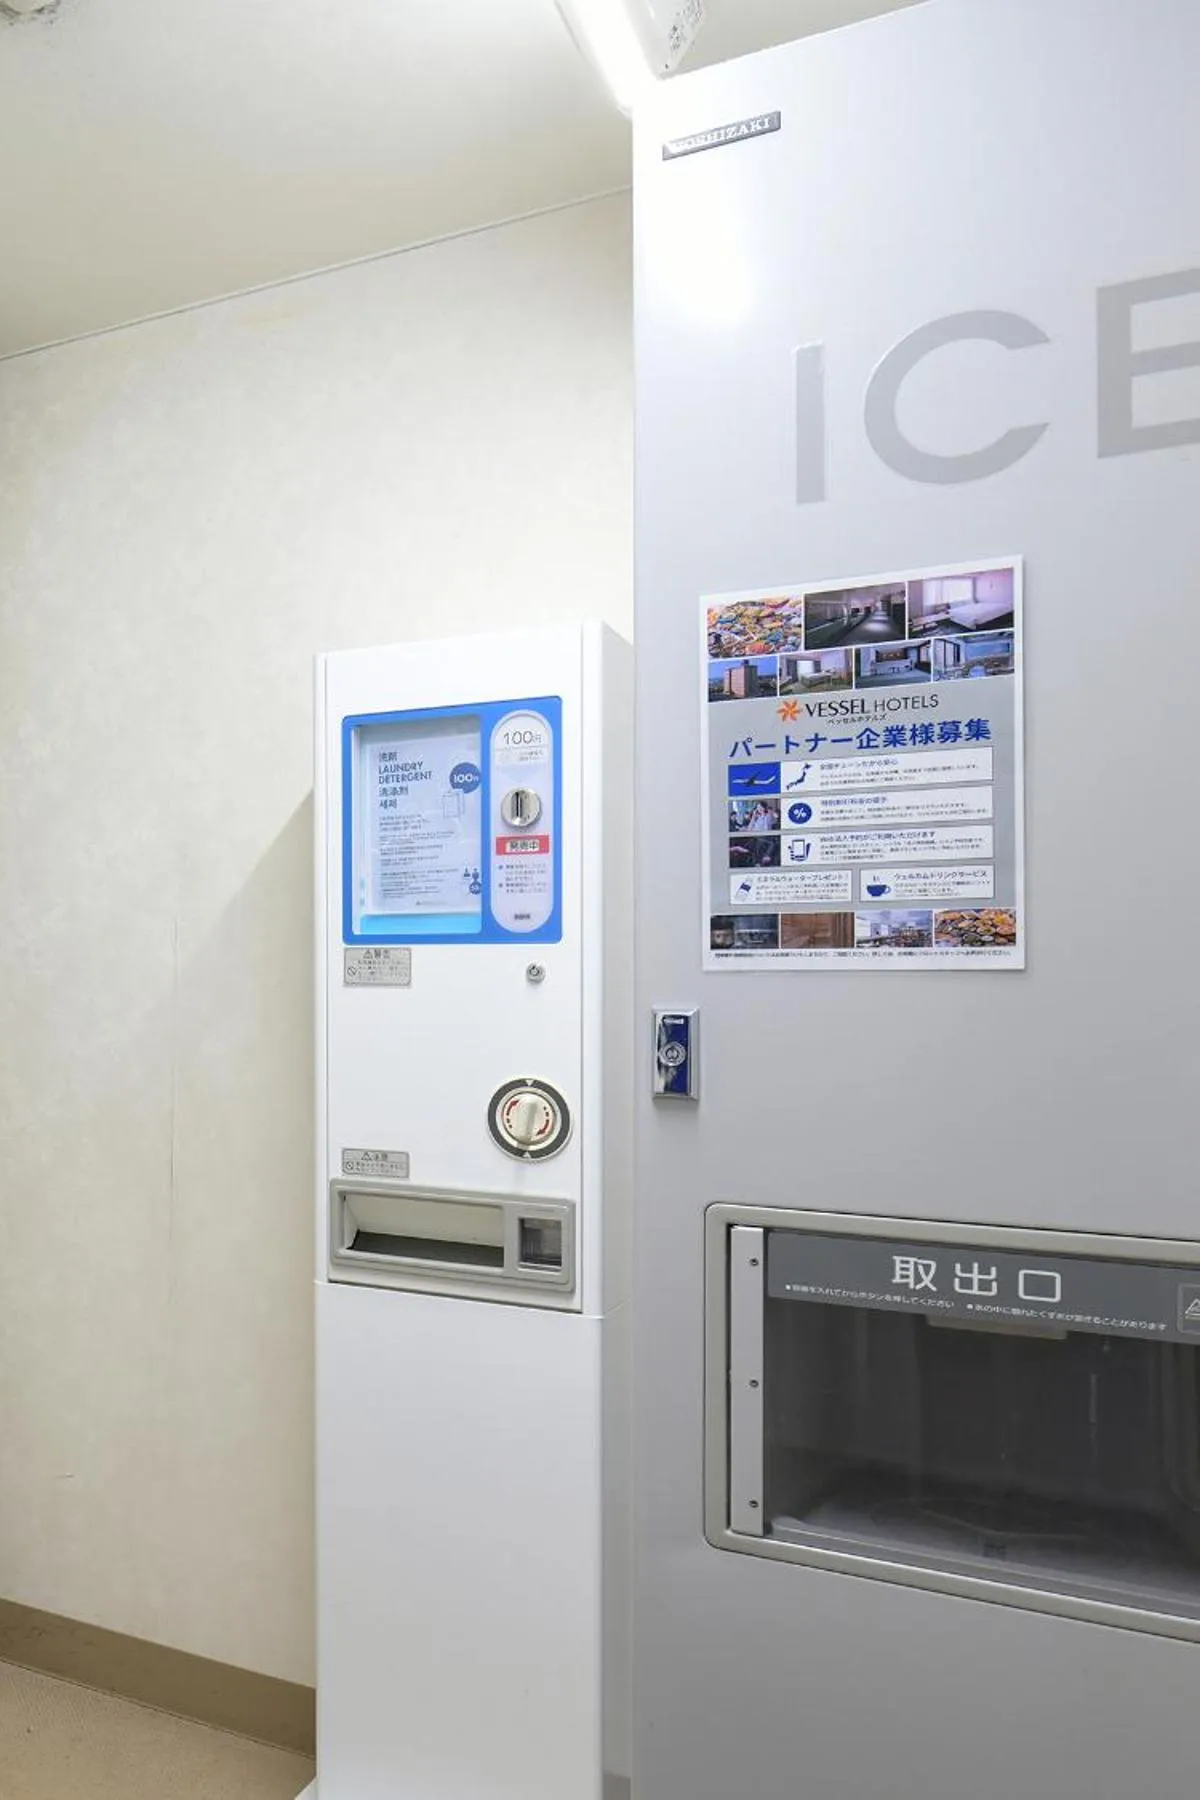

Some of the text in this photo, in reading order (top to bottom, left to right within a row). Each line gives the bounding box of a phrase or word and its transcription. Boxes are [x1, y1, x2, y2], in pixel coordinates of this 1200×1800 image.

[794, 267, 1200, 504] ICE
[804, 694, 939, 718] VESSEL HOTELS
[827, 713, 888, 725] ベッセルホテルズ
[729, 717, 992, 758] パートナー企業様募集
[378, 760, 424, 774] LAUNDRY
[378, 771, 432, 784] DETERGENT
[891, 1255, 1062, 1303] 取出口
